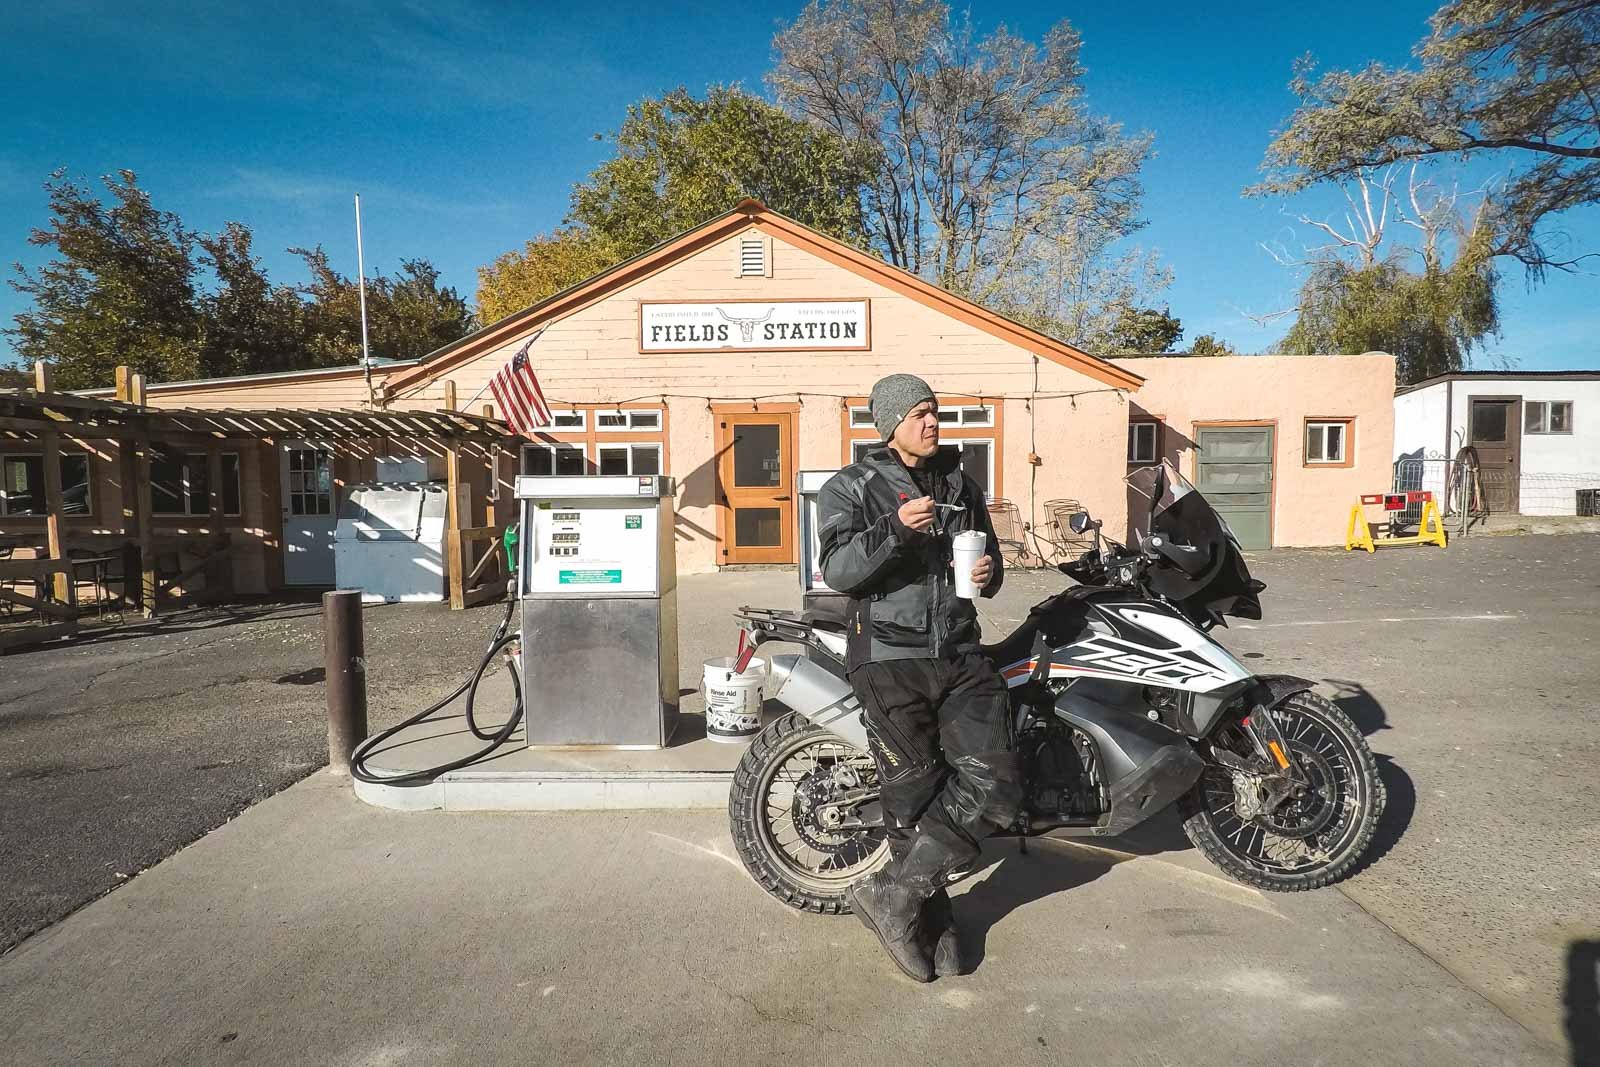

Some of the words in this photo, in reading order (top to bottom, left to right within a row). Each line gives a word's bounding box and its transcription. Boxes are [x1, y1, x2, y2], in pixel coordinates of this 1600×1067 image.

[651, 324, 729, 342] FIELDS
[764, 321, 857, 340] STATION
[711, 688, 726, 697] Rinse
